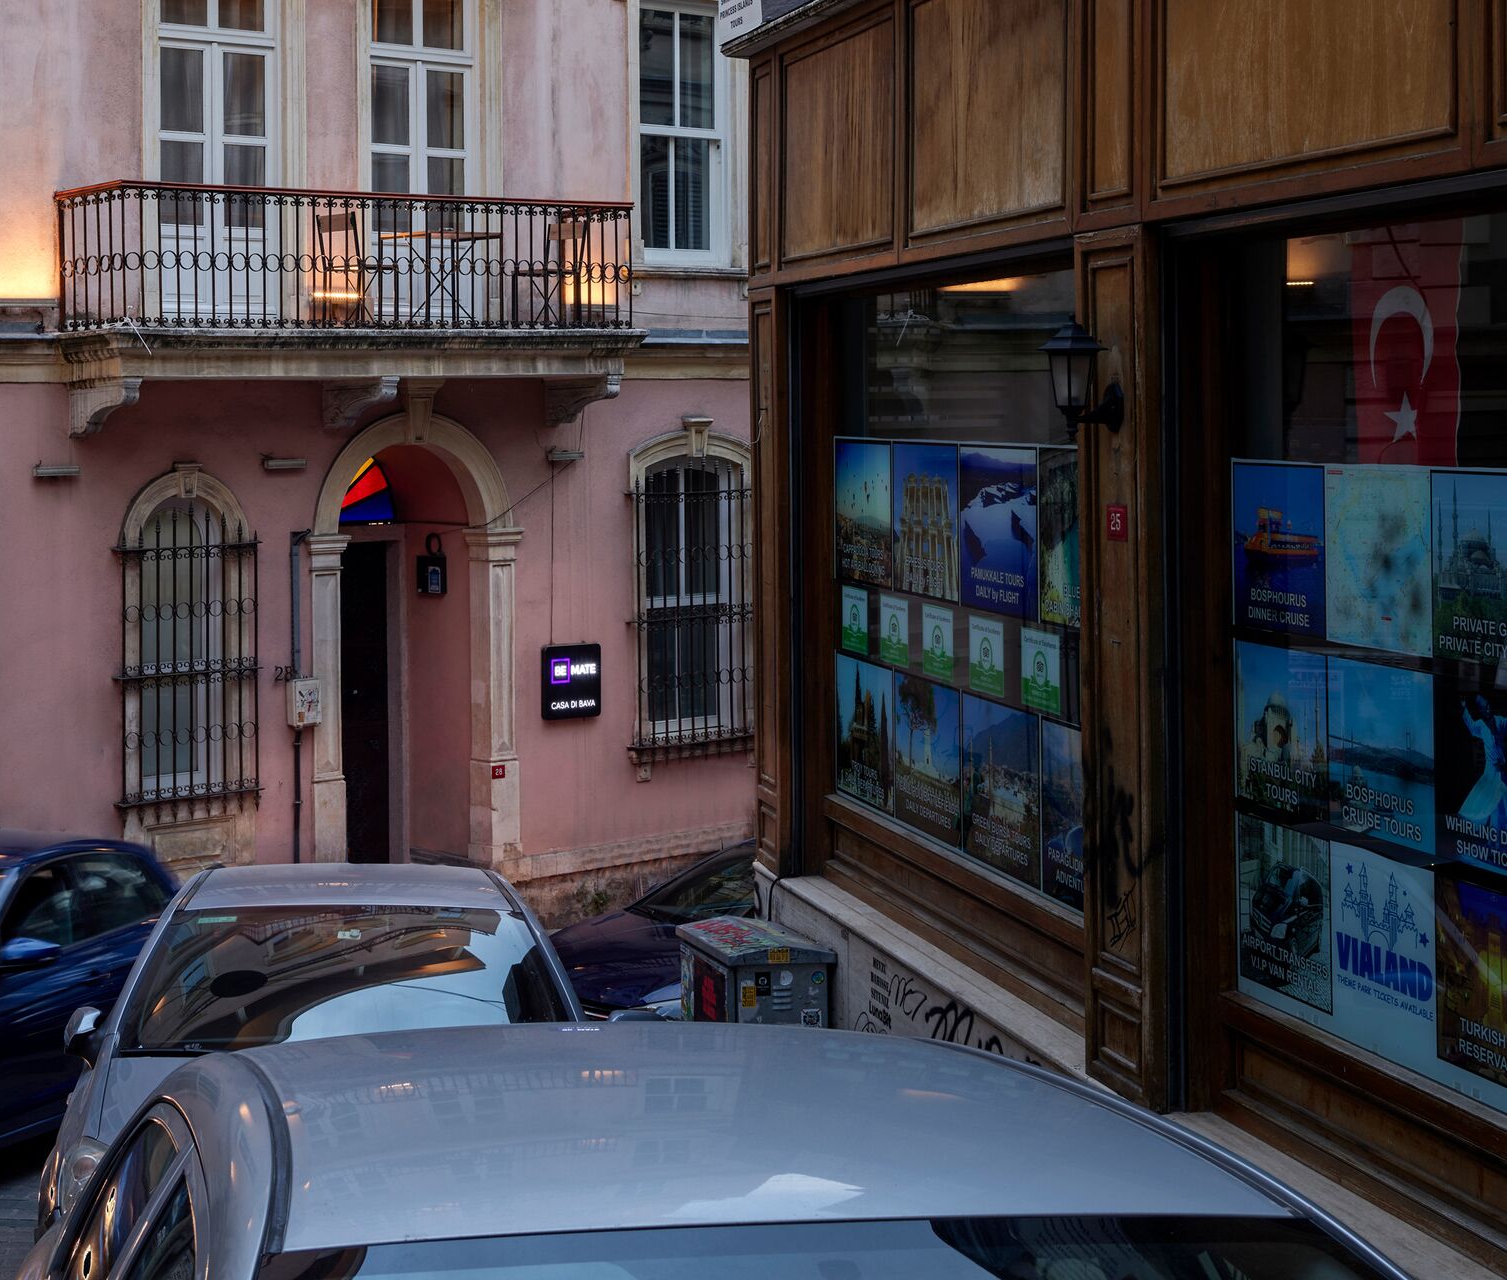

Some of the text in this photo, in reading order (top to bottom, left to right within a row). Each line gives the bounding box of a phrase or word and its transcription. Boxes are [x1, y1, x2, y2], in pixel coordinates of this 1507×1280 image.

[1110, 512, 1121, 531] 25
[971, 566, 1025, 588] PAMUKKALE TOURS
[975, 585, 1020, 605] DAILY by FLIGHT
[1250, 588, 1307, 607] BOSPHOURUS
[1248, 605, 1310, 627] DINNER CRUISE
[1453, 616, 1496, 635] PRIVATE
[1439, 635, 1482, 655] PRIVATE
[275, 666, 293, 681] 28
[554, 663, 597, 677] BE MATE
[551, 699, 596, 710] CASA DI BAVA
[495, 767, 503, 776] 28
[1294, 768, 1317, 788] CITY
[1265, 782, 1299, 805] TOURS
[1345, 783, 1414, 815] BOSPHORUS
[1342, 805, 1422, 841] CRUISE TOURS
[1445, 814, 1497, 842] WHIRLING
[1456, 839, 1489, 861] SHOW
[1242, 933, 1328, 978] AIRPORT TRANSFERS
[1336, 931, 1432, 1001] VIALAND
[1268, 961, 1285, 981] VAN
[1286, 971, 1321, 995] RENTAL
[1337, 973, 1434, 1022] THEME PARK TICKETS AVAILABLE
[1459, 1017, 1506, 1049] TURKISH
